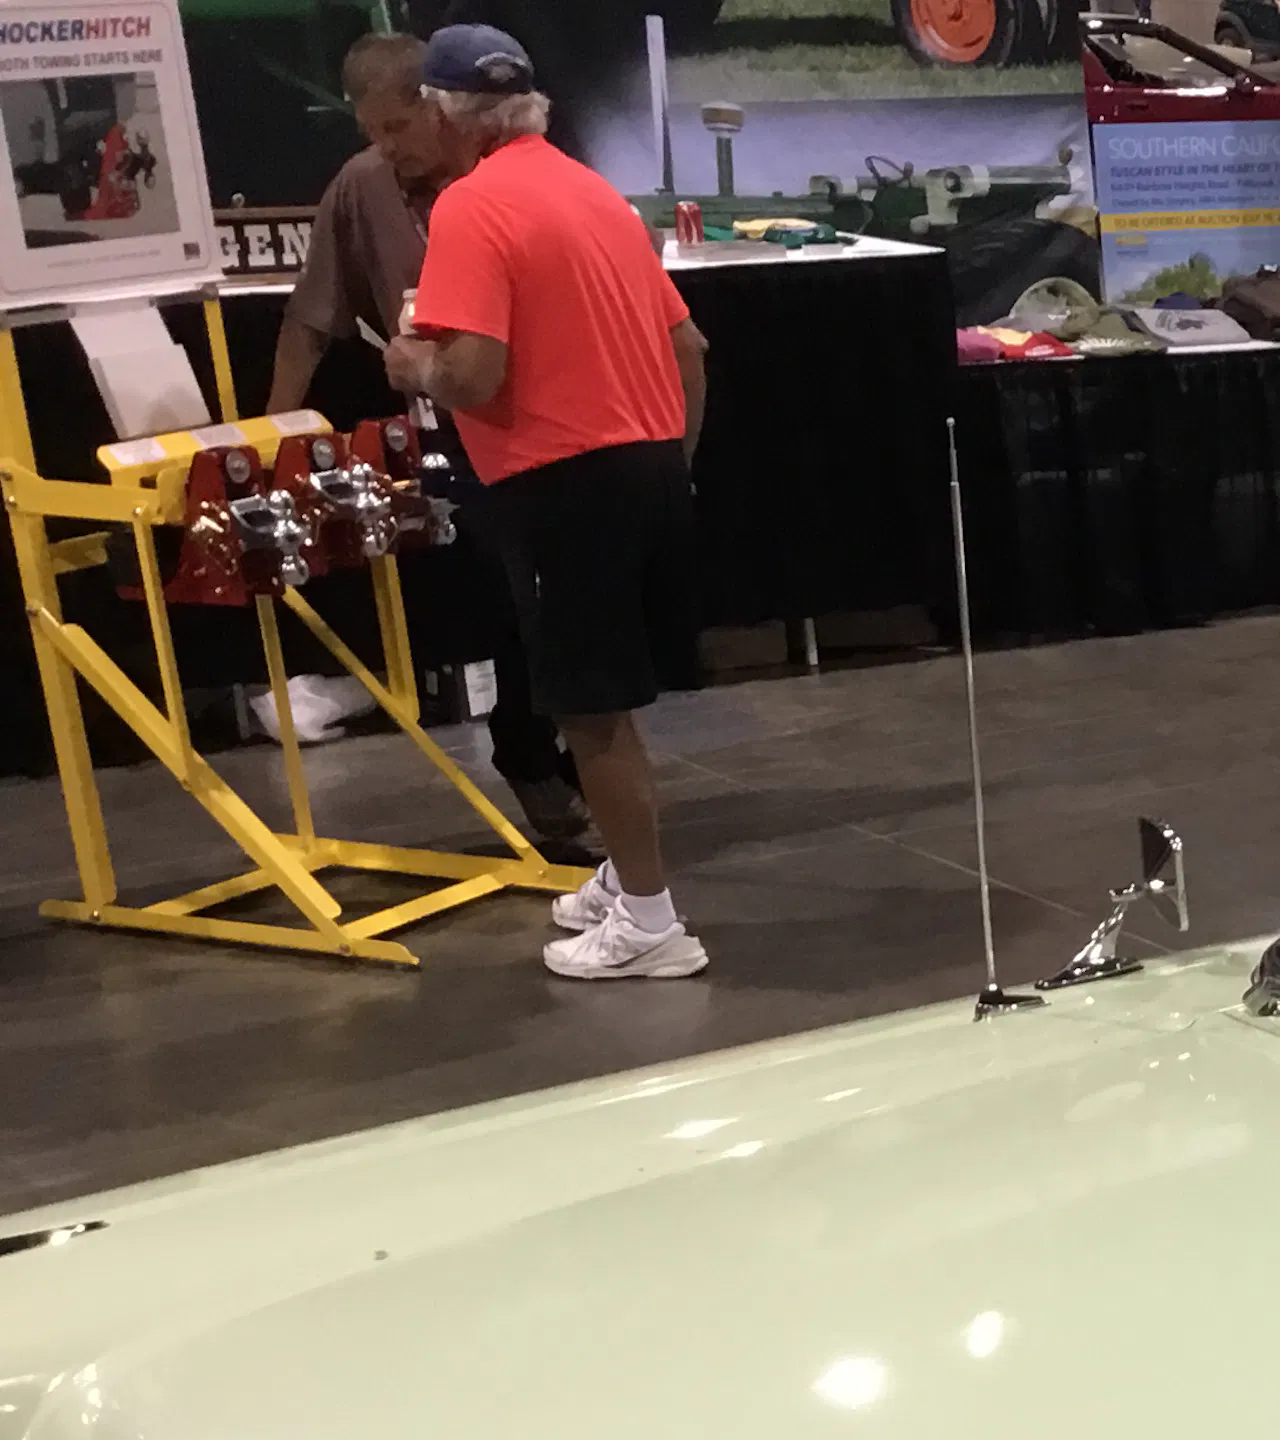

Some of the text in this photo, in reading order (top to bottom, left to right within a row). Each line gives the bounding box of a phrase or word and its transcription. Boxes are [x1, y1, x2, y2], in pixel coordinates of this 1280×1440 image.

[33, 54, 81, 69] TOWING
[84, 50, 129, 66] STARTS
[133, 48, 163, 63] HERE
[1108, 136, 1216, 160] SOUTHERN
